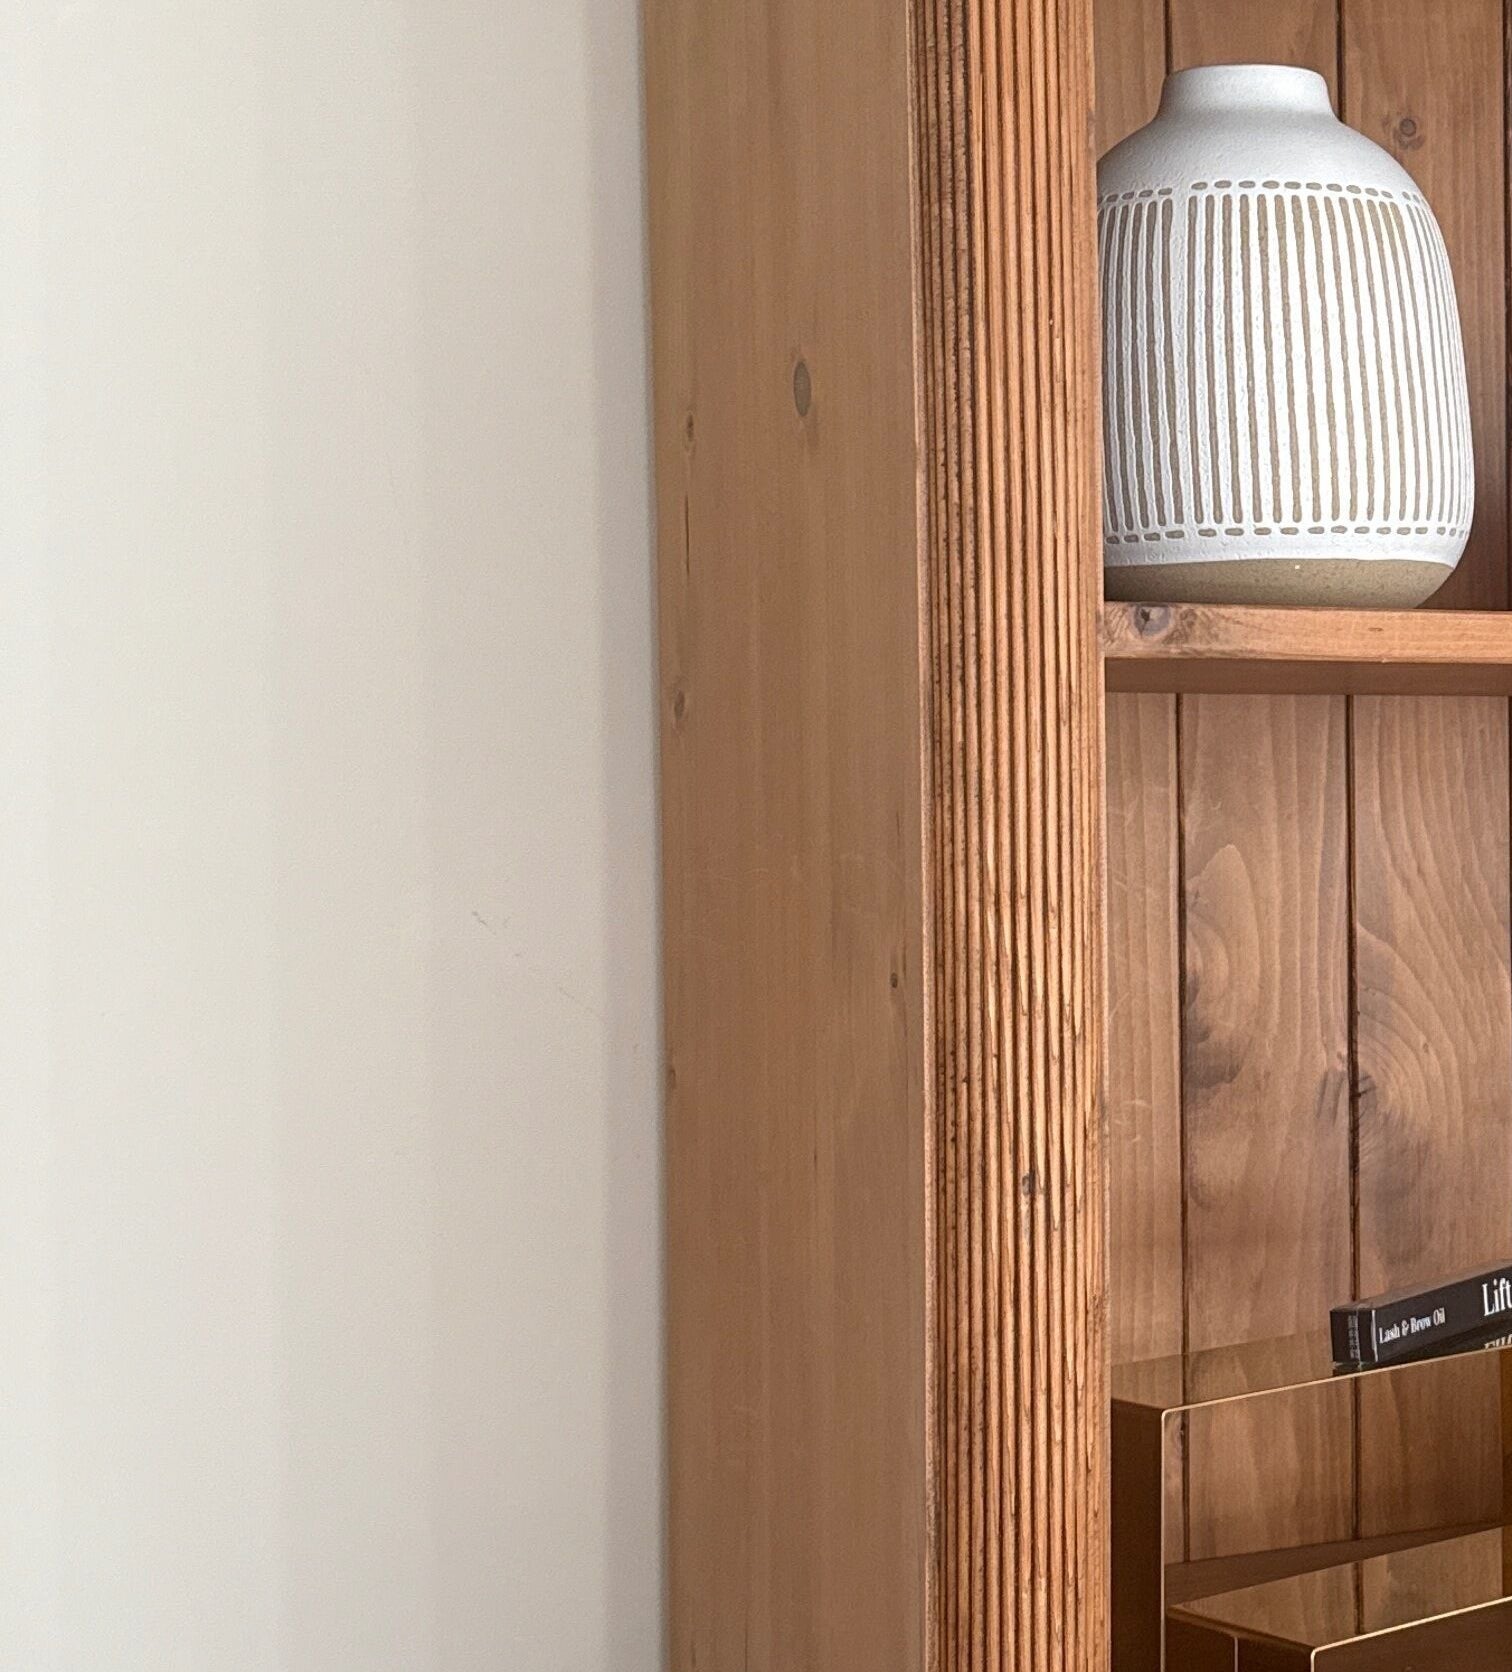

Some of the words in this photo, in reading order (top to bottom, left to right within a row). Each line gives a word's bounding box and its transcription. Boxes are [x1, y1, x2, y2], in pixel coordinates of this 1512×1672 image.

[1379, 1324, 1400, 1344] Lash
[1401, 1320, 1409, 1337] &
[1410, 1316, 1431, 1333] Brow
[1433, 1307, 1446, 1326] Oil
